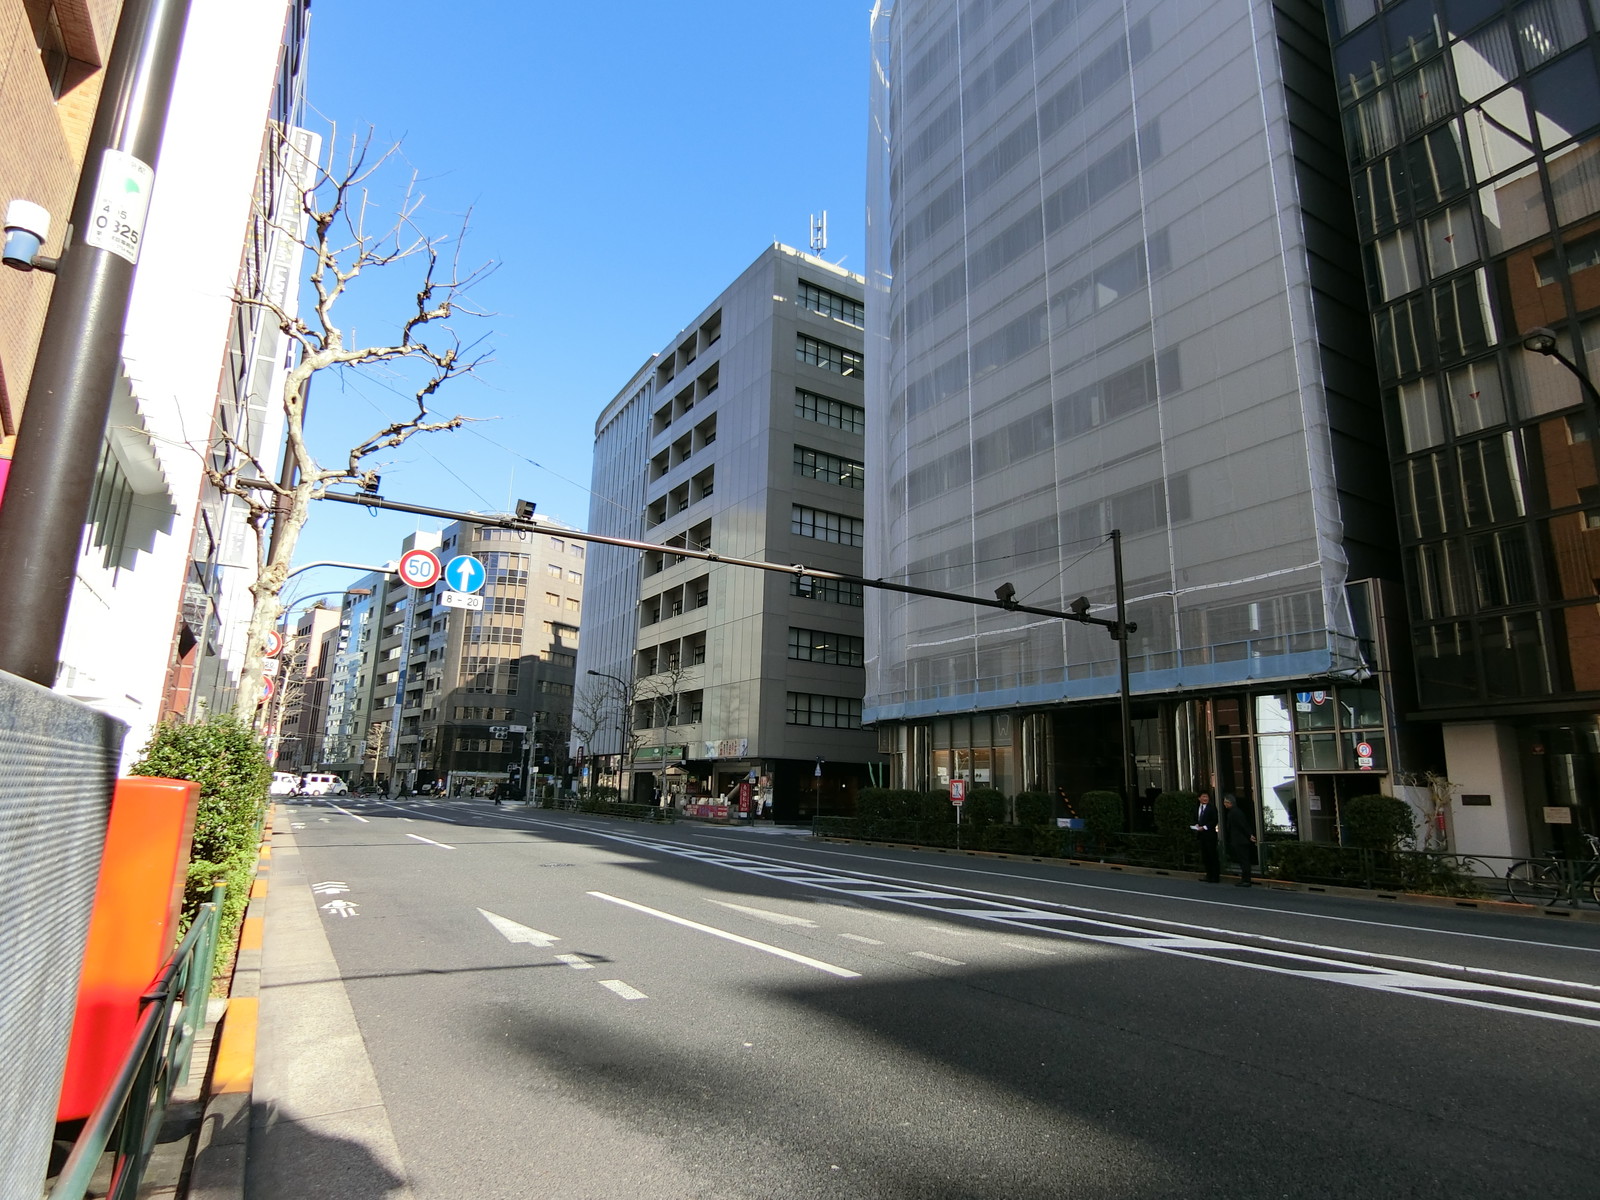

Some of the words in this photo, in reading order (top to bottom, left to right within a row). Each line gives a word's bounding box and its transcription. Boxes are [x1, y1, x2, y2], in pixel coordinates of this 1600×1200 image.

[103, 205, 127, 220] 45
[408, 559, 431, 577] 50
[446, 594, 452, 603] 8
[467, 598, 478, 606] 20
